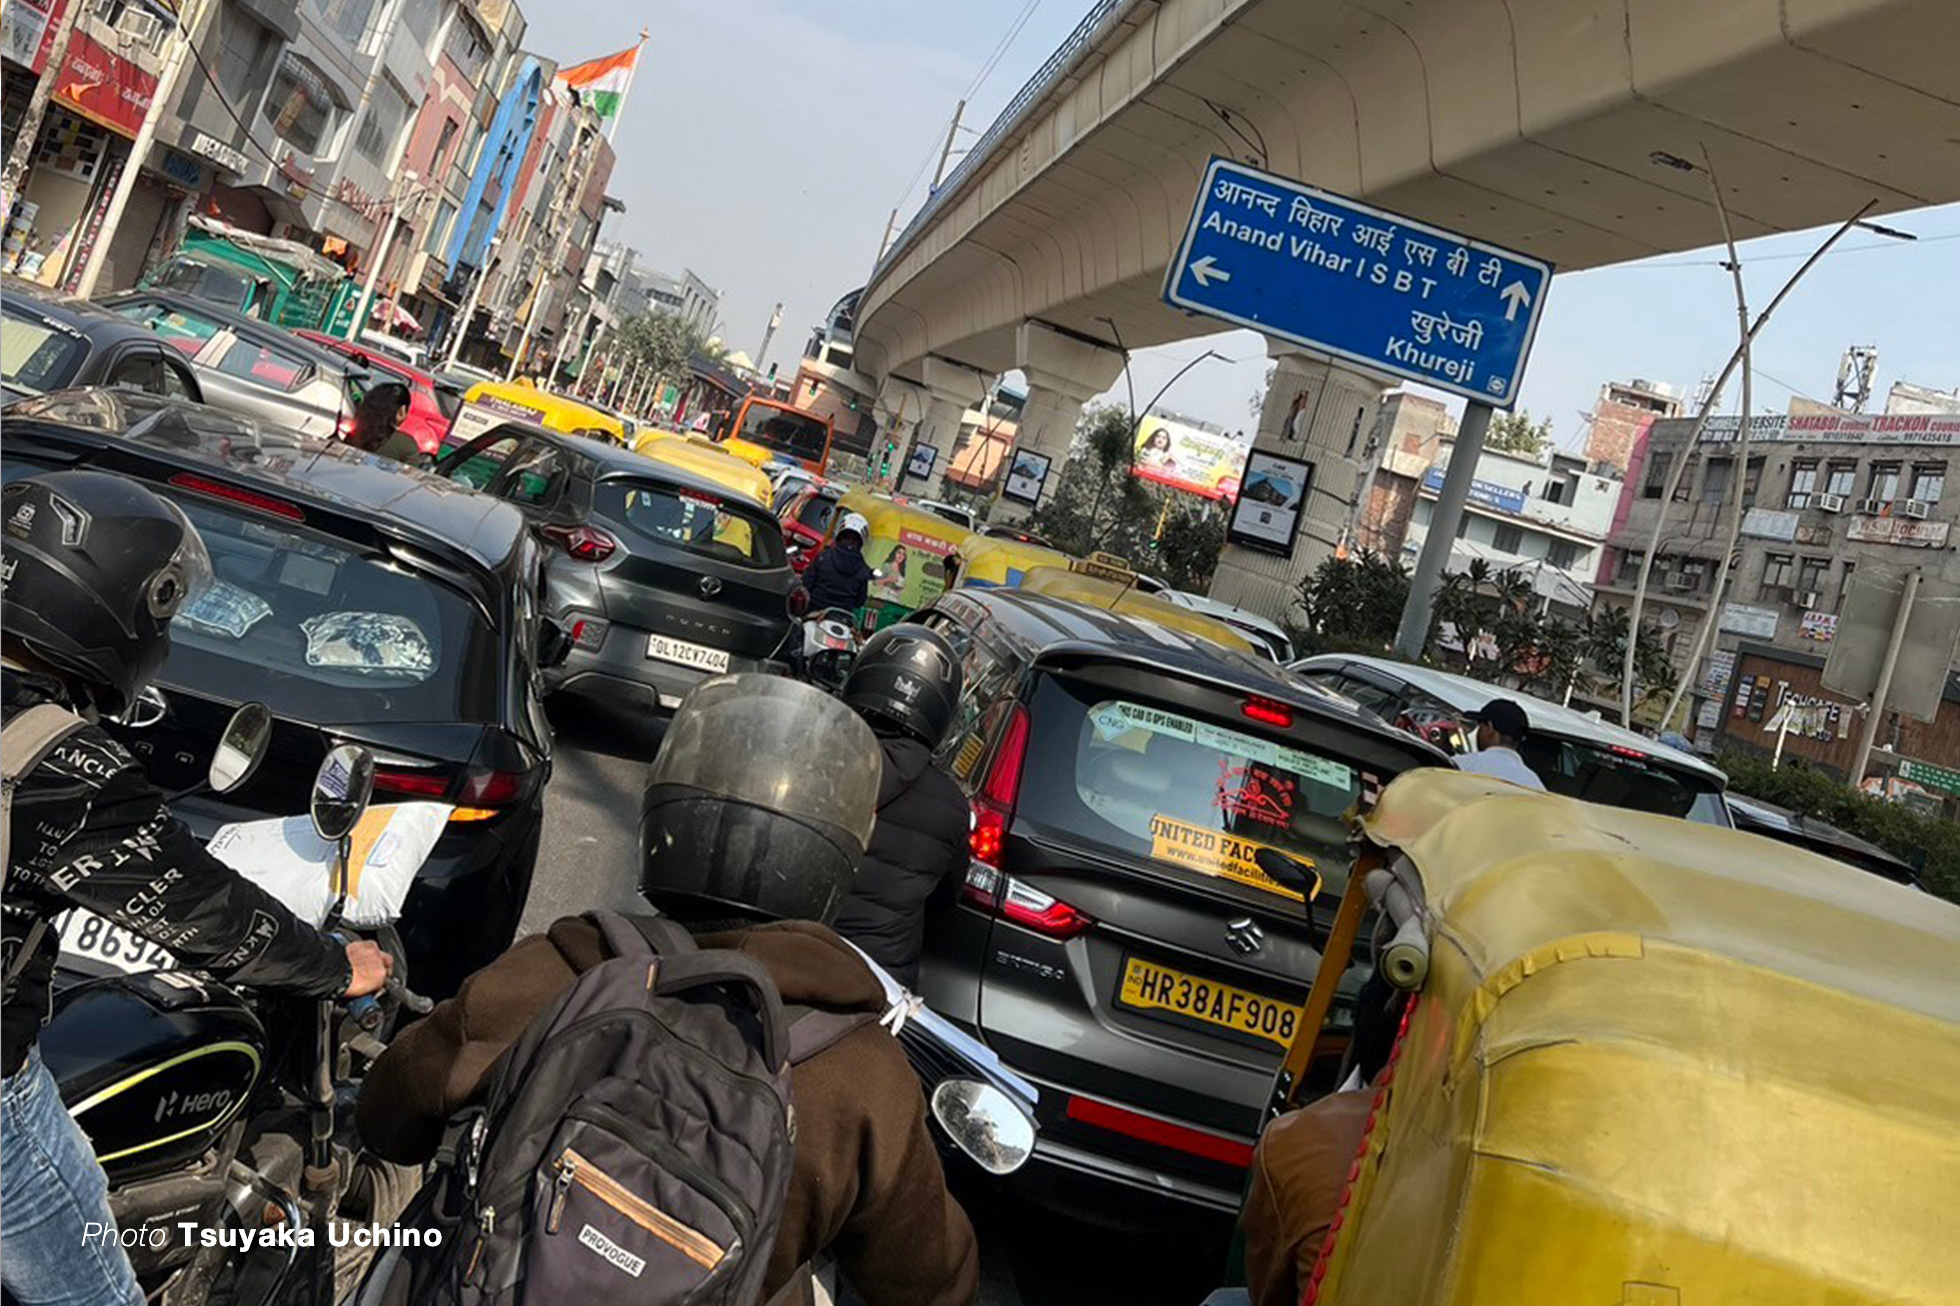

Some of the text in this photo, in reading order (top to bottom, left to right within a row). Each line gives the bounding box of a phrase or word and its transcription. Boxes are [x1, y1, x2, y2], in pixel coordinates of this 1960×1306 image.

[1203, 211, 1438, 299] Anand Vihar I S B T
[1214, 180, 1503, 288] आनन्द विहार आई एस बी टी
[1411, 310, 1484, 351] खुरेजी
[1385, 336, 1475, 383] Khureji
[1872, 416, 1931, 432] TRACKON
[1099, 715, 1125, 730] CNG
[1219, 838, 1258, 863] FAC
[581, 1229, 642, 1274] PROVOGUE
